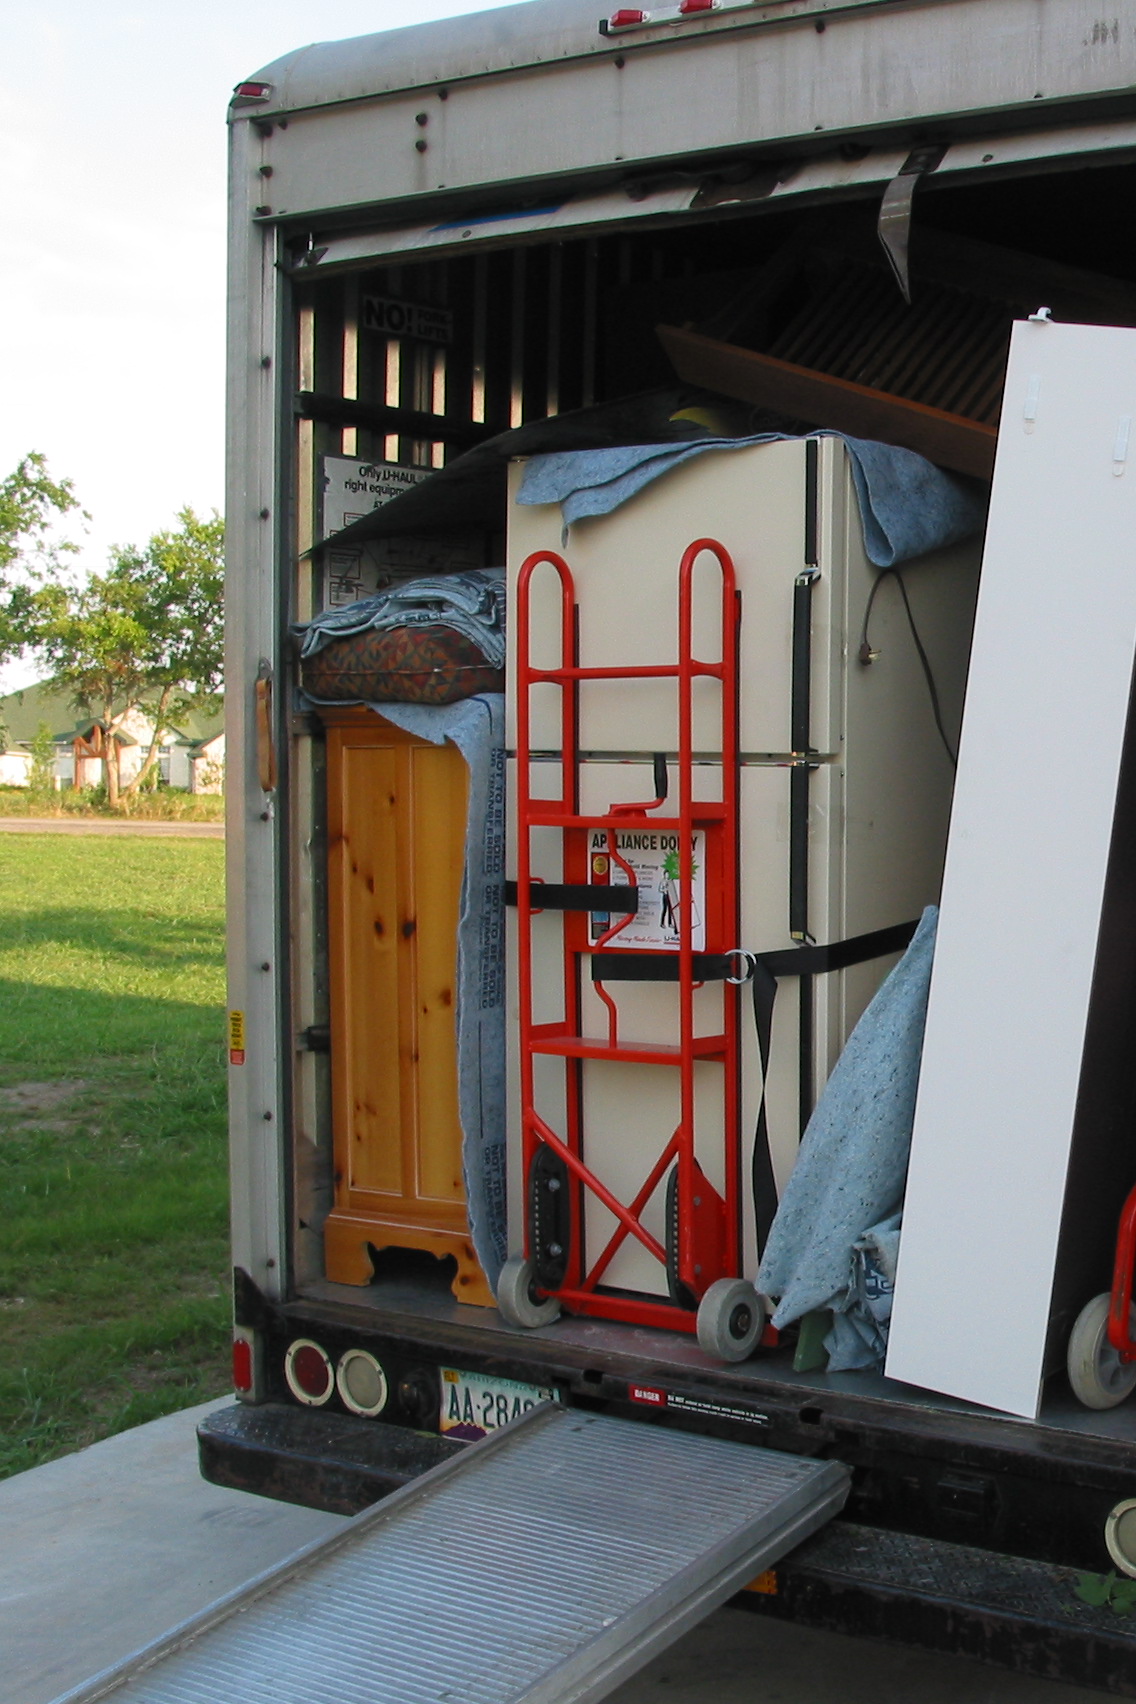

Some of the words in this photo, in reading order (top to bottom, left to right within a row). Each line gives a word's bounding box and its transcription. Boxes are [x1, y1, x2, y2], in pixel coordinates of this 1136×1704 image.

[366, 300, 412, 332] NO!
[358, 466, 381, 482] Only
[383, 469, 418, 484] U-HAUL
[344, 479, 367, 493] right
[592, 834, 658, 851] APLIANCE
[634, 1389, 660, 1402] DANGER
